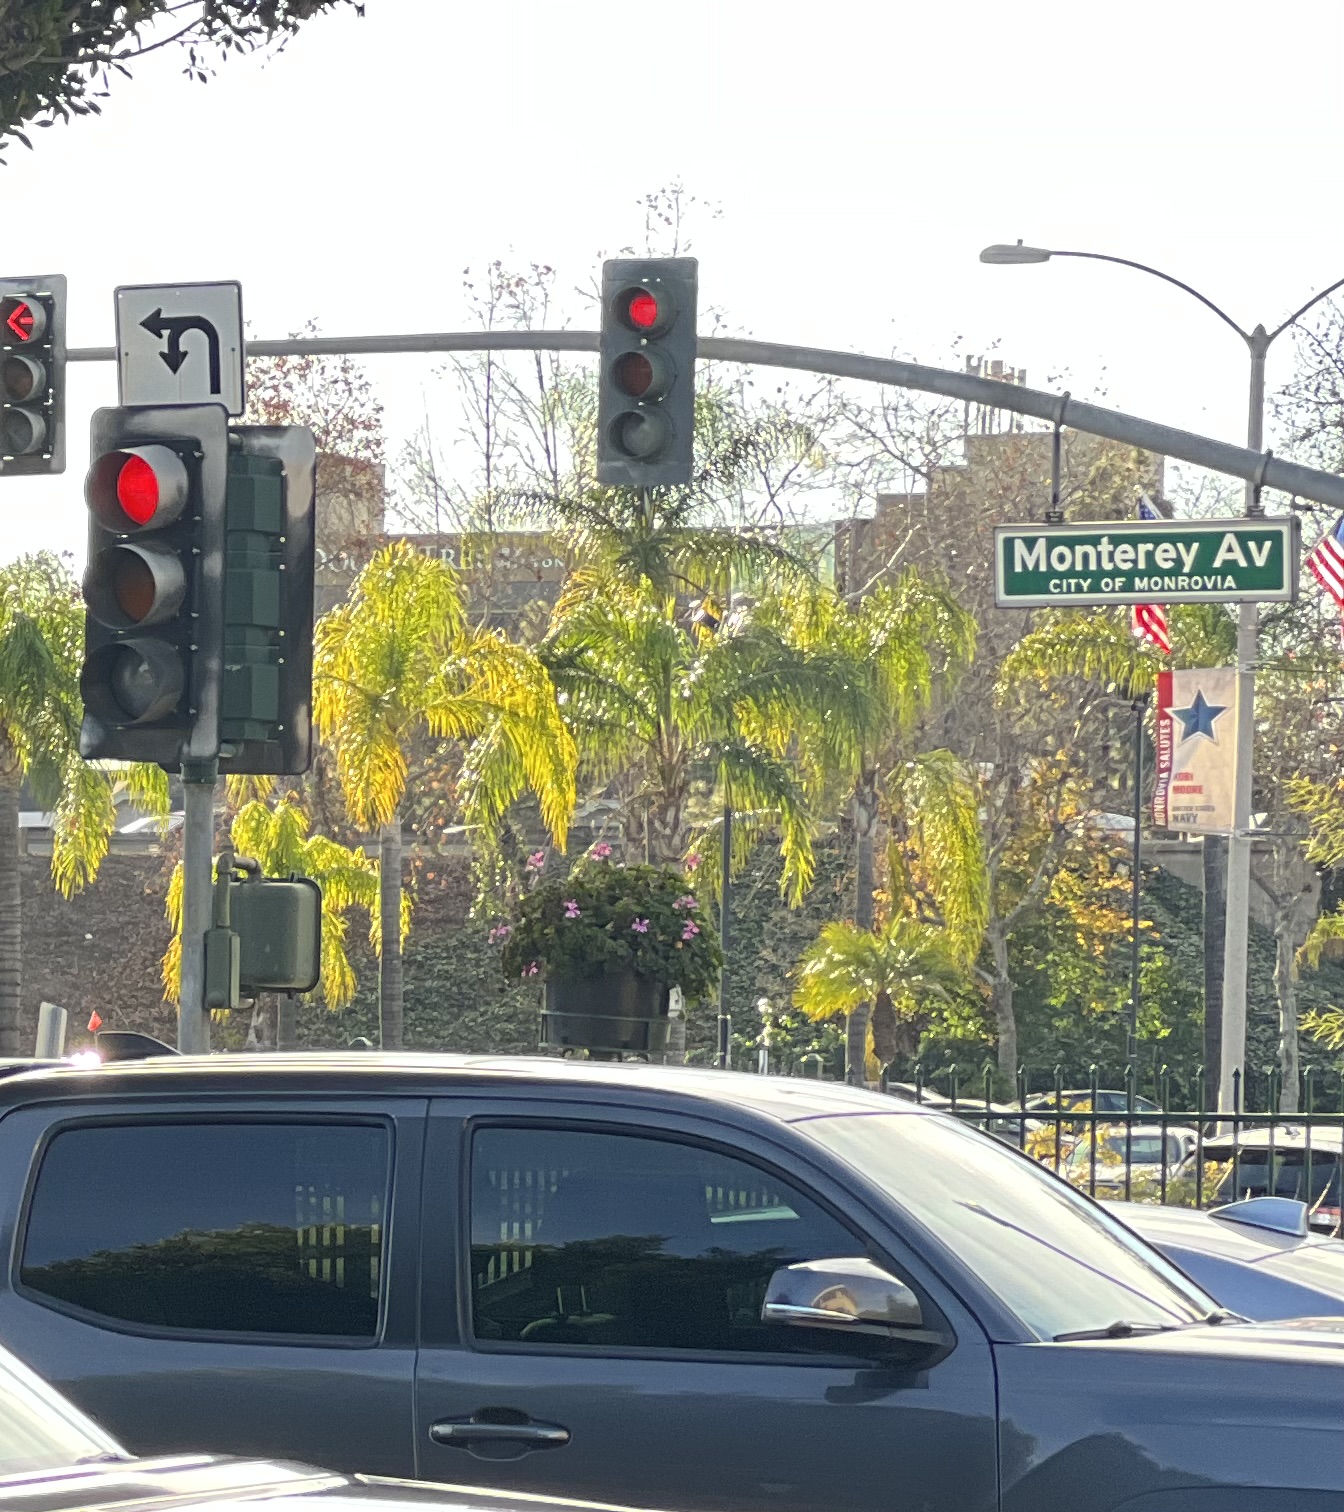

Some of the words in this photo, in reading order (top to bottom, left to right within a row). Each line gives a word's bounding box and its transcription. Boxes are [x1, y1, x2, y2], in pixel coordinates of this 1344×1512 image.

[1014, 536, 1200, 573] Monterey
[1212, 532, 1273, 568] Av
[1049, 578, 1093, 593] CITY
[1100, 577, 1127, 592] OF
[1134, 575, 1237, 591] MONROVIA
[1159, 718, 1171, 769] SALUTES
[1172, 813, 1198, 824] NAVY
